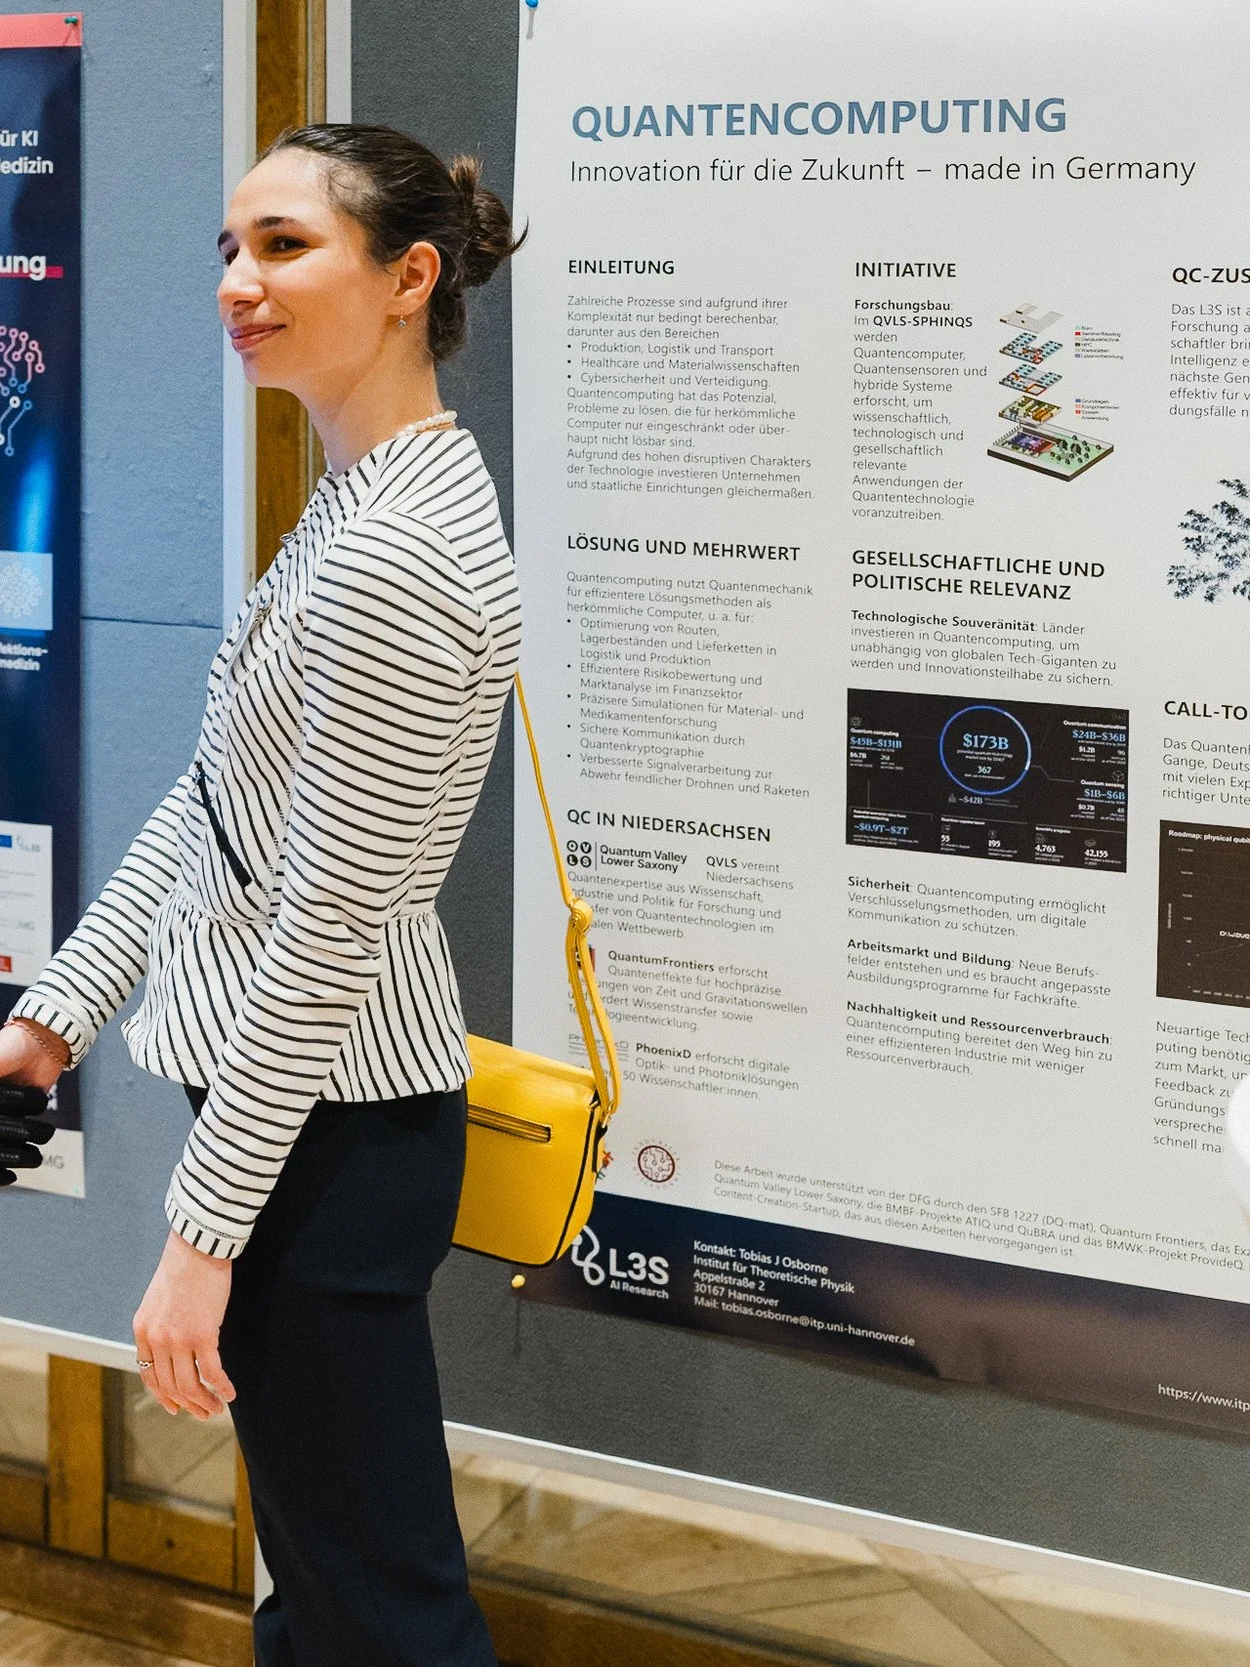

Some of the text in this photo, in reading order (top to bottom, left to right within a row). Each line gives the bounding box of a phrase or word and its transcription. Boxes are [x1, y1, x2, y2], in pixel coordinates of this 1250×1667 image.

[572, 98, 1067, 142] QUANTENCOMPUTING
[20, 128, 39, 145] KI
[570, 157, 701, 181] Innovation
[710, 157, 743, 180] für
[753, 156, 792, 180] die
[801, 156, 904, 179] Zukunft
[944, 155, 1021, 178] made
[1030, 155, 1055, 178] in
[1065, 154, 1195, 183] Germany
[568, 259, 674, 274] EINLEITUNG
[854, 262, 955, 277] INITIATIVE
[567, 295, 787, 310] Zahlreiche Prozesse sind aufgrund ihrer
[854, 298, 953, 313] Forschungsbau:
[1171, 303, 1240, 315] Das L3S ist
[854, 314, 972, 328] Im QVLS-SPHINQS
[1170, 320, 1238, 335] Forschung
[580, 356, 800, 372] Healthcare und Materialwissenschaften
[853, 362, 987, 376] Quantensensoren und
[1170, 353, 1237, 369] Intelligenz
[852, 410, 952, 426] wissenschaftlich,
[567, 532, 798, 560] LÖSUNG UND MEHRWERT
[852, 548, 1104, 578] GESELLSCHAFTLICHE UND
[566, 570, 813, 595] Quantencomputing nutzt Quantenmechanik
[852, 572, 1070, 600] POLITISCHE RELEVANZ
[851, 608, 1083, 635] Technologische Souveränität: Länder
[579, 722, 745, 746] Sichere Kommunikation durch
[963, 733, 1009, 750] $173B
[1162, 770, 1228, 787] mit vielen
[567, 808, 770, 842] QC IN NIEDERSACHSEN
[1167, 828, 1234, 842] Roadmap: physical
[598, 842, 687, 866] Quantum Valley
[598, 853, 678, 875] Lower Saxony
[705, 854, 779, 873] QVLS vereint
[847, 874, 1105, 914] Sicherheit: Quantencomputing ermöglicht
[607, 948, 767, 979] QuantumFrontiers erforscht
[847, 936, 1101, 978] Arbeitsmarkt und Bildung: Neue Berufs-
[846, 998, 1112, 1045] Nachhaltigkeit und Ressourcenverbrauch:
[1155, 1020, 1220, 1041] Neuartige
[635, 1040, 691, 1059] PhoenixD
[695, 1051, 744, 1067] erforscht
[748, 1057, 789, 1073] digitale
[1154, 1077, 1218, 1095] Feedback
[608, 1248, 669, 1284] L3S
[693, 1239, 828, 1274] Kontakt: Tobias J Osborne
[692, 1253, 854, 1294] Institut für Theoretische Physik
[693, 1267, 765, 1291] Appelstraße 2
[609, 1278, 669, 1299] AI Research
[693, 1281, 778, 1307] 30167 Hannover
[693, 1294, 915, 1346] Mail: tobias.osborne@itp.uni-hannover.de
